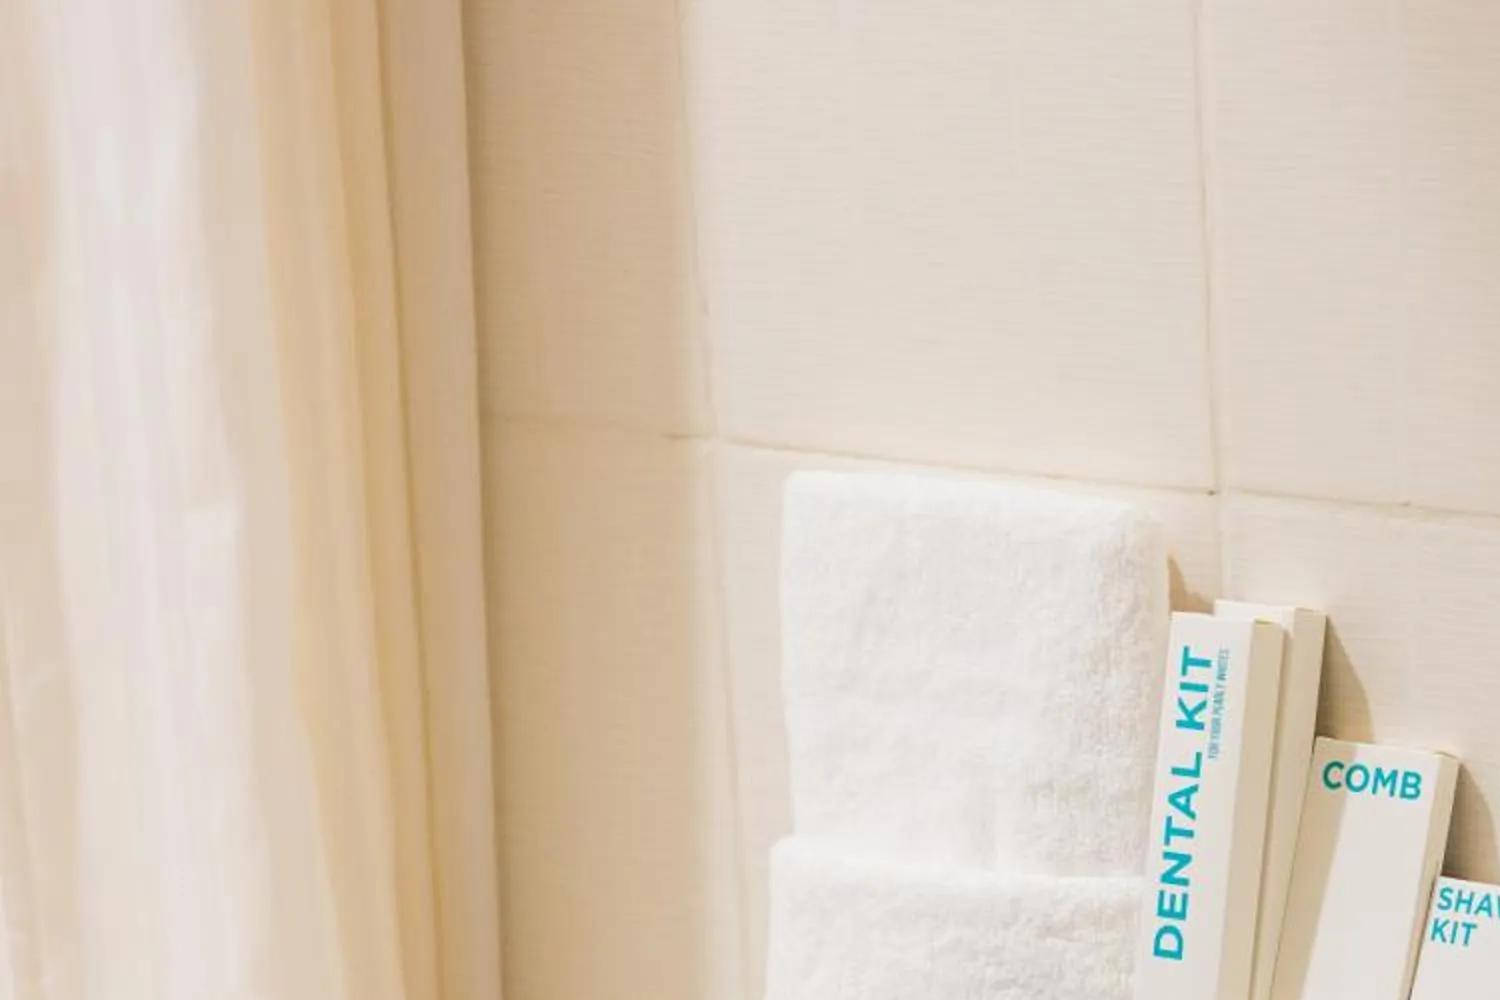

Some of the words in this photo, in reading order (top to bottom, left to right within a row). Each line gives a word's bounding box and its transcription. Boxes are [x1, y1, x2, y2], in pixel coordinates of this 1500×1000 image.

[1174, 645, 1213, 731] KIT
[1321, 760, 1423, 800] COMB
[1152, 751, 1203, 961] DENTAL
[1430, 917, 1478, 947] KIT
